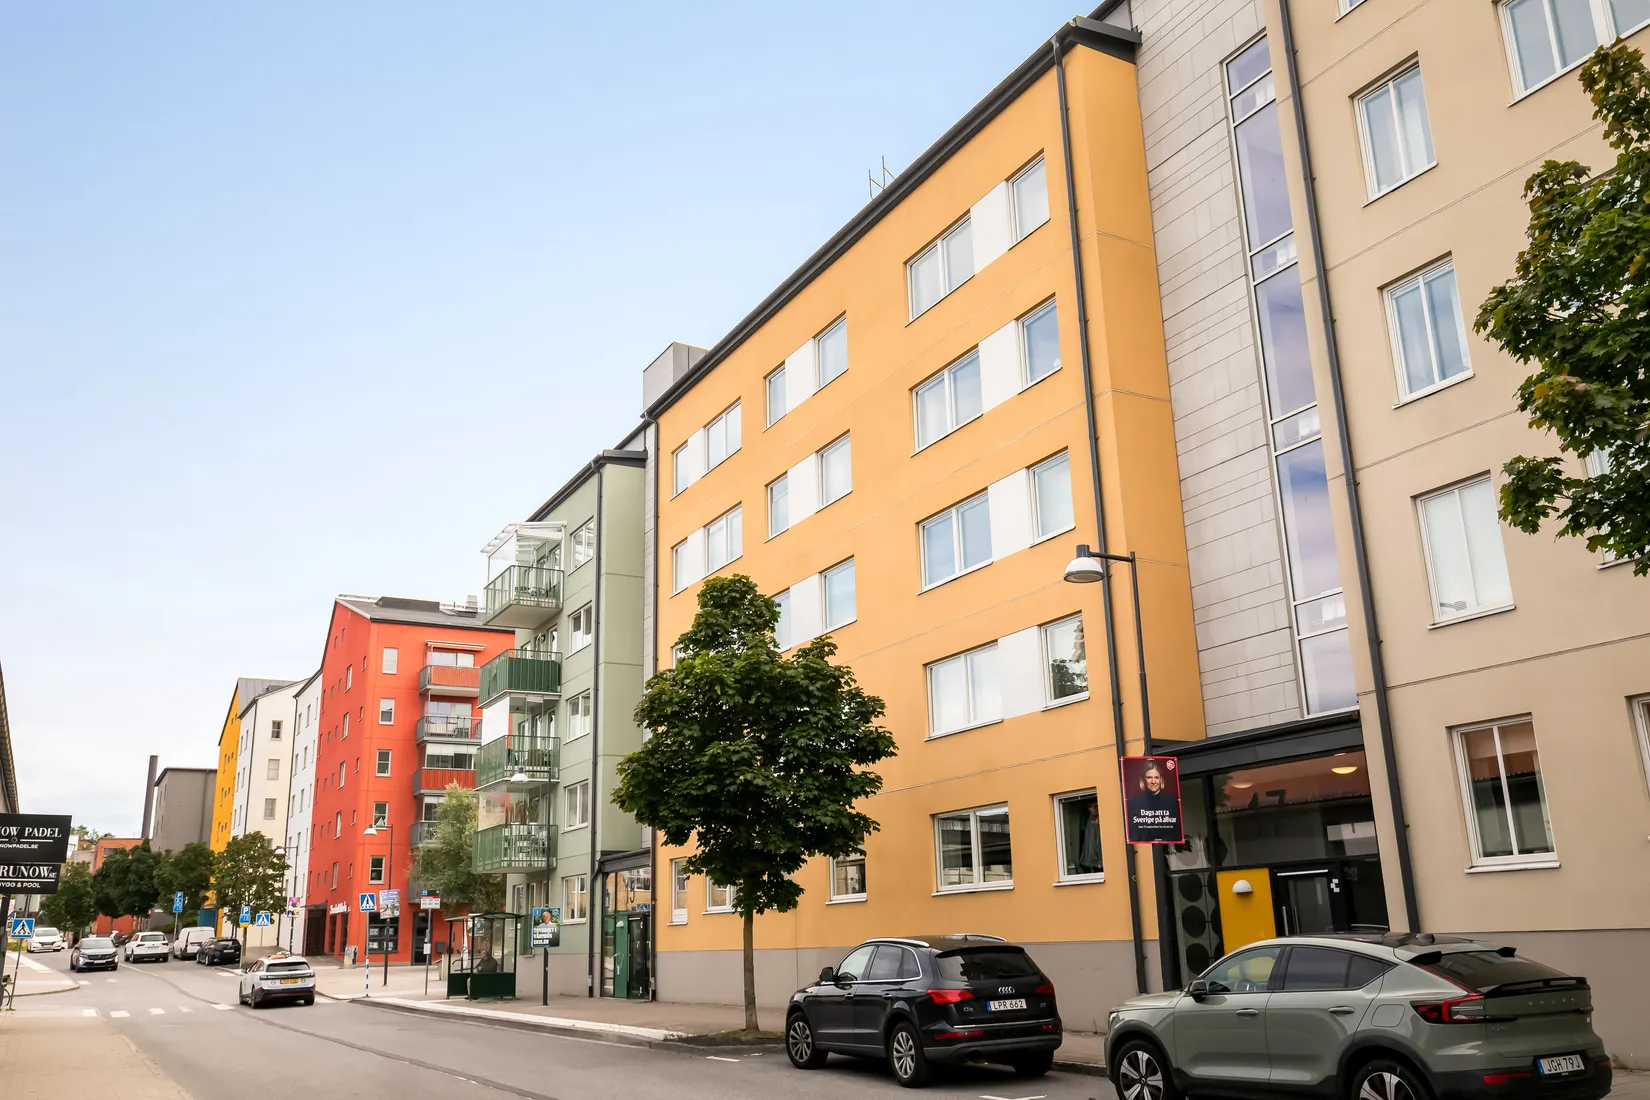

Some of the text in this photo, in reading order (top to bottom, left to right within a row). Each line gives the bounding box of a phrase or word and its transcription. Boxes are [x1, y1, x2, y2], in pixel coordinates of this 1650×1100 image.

[1140, 809, 1154, 817] Dags
[1133, 816, 1154, 824] Sverige
[1154, 816, 1163, 824] på
[0, 826, 62, 838] OW PADEL
[993, 1000, 1024, 1010] LPR 662
[1546, 1059, 1562, 1072] JGH
